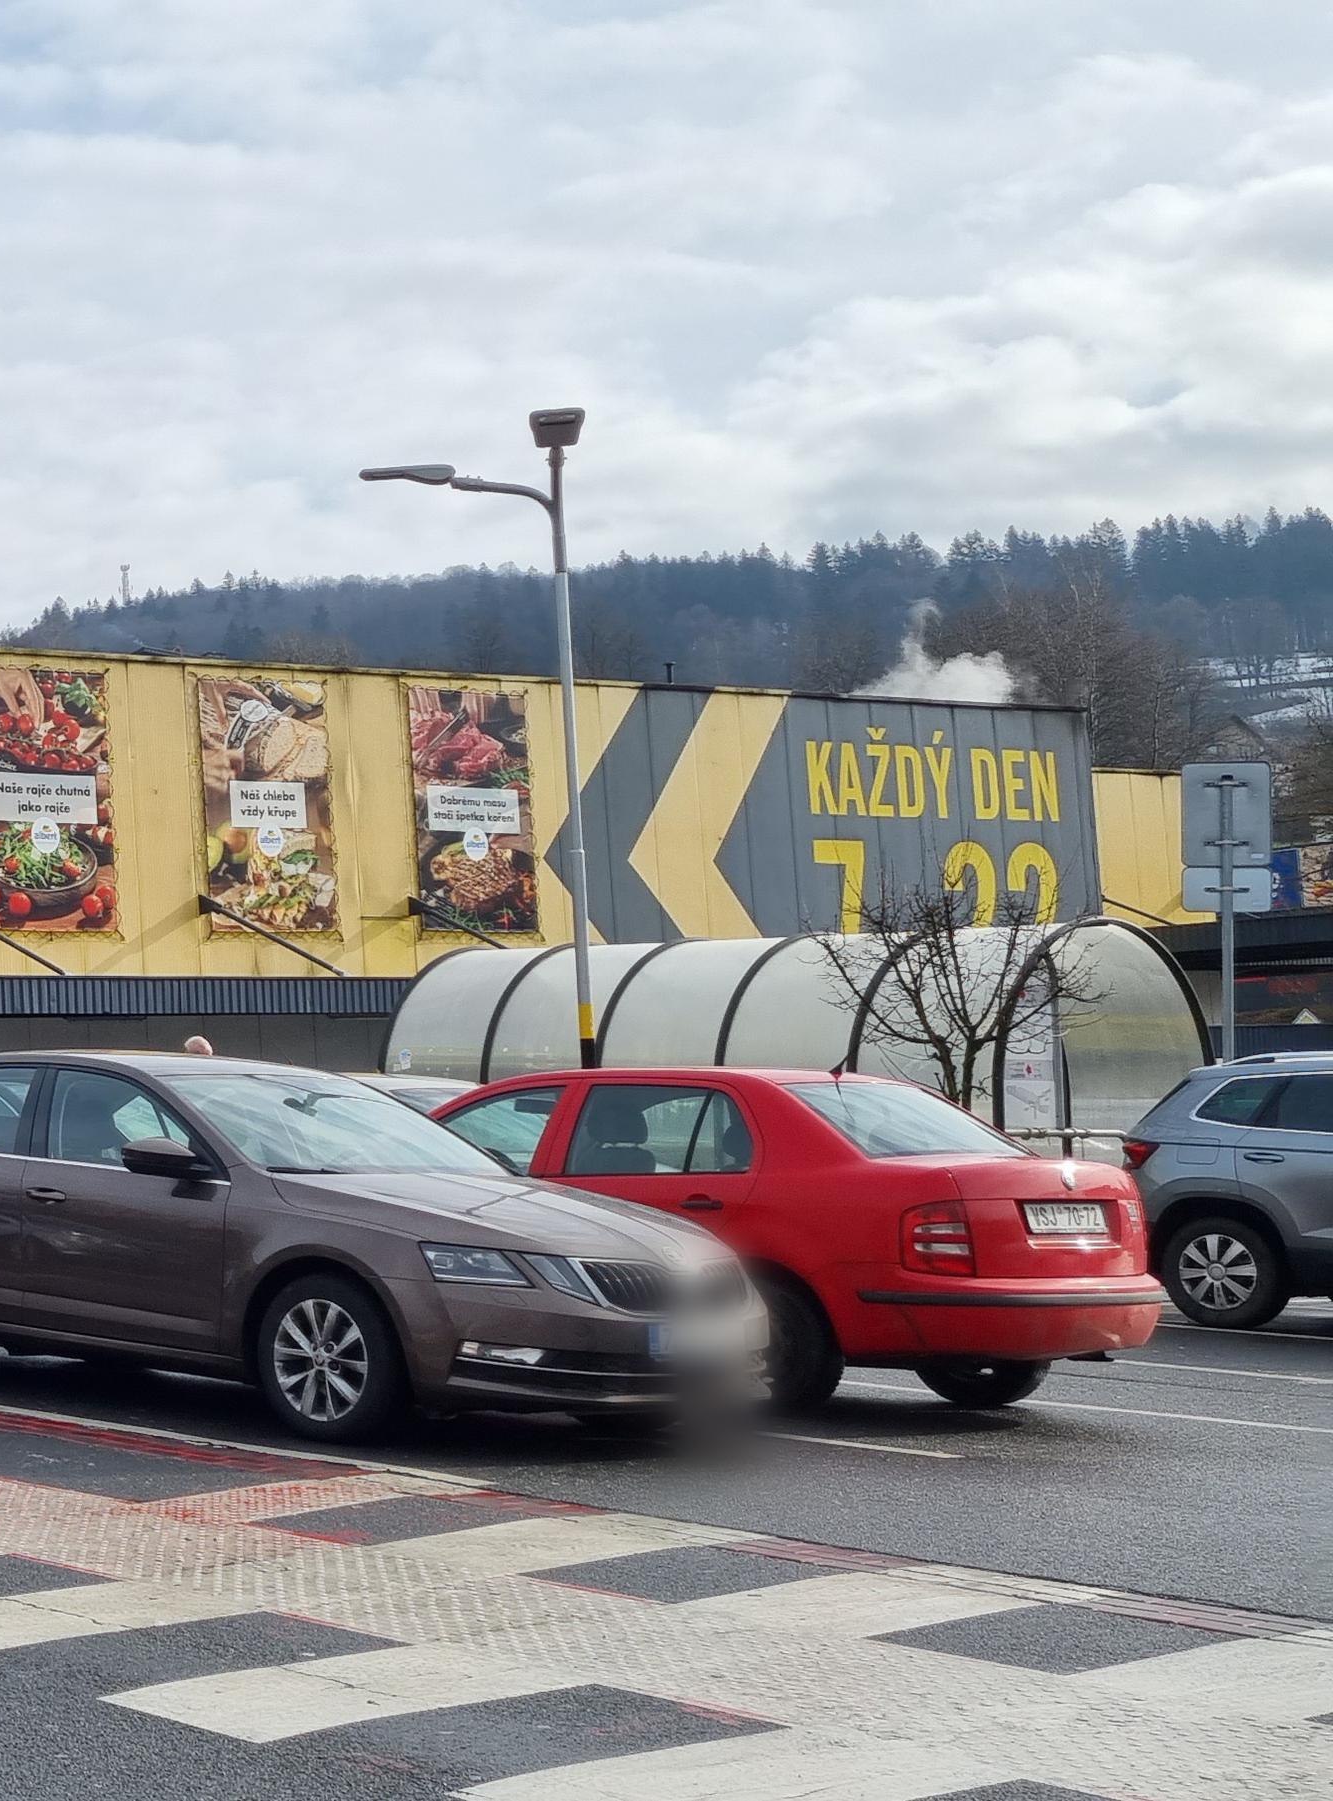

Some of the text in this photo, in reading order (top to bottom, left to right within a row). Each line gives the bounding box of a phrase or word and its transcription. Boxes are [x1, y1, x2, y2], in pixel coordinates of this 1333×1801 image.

[805, 727, 1060, 822] KAŽDÝ DEN
[26, 784, 52, 798] rajče
[55, 784, 91, 797] chutná
[240, 790, 295, 801] Náš chleba
[18, 800, 71, 816] jako rajče
[240, 805, 297, 820] vždy křupe
[1030, 1205, 1058, 1226] VSJ
